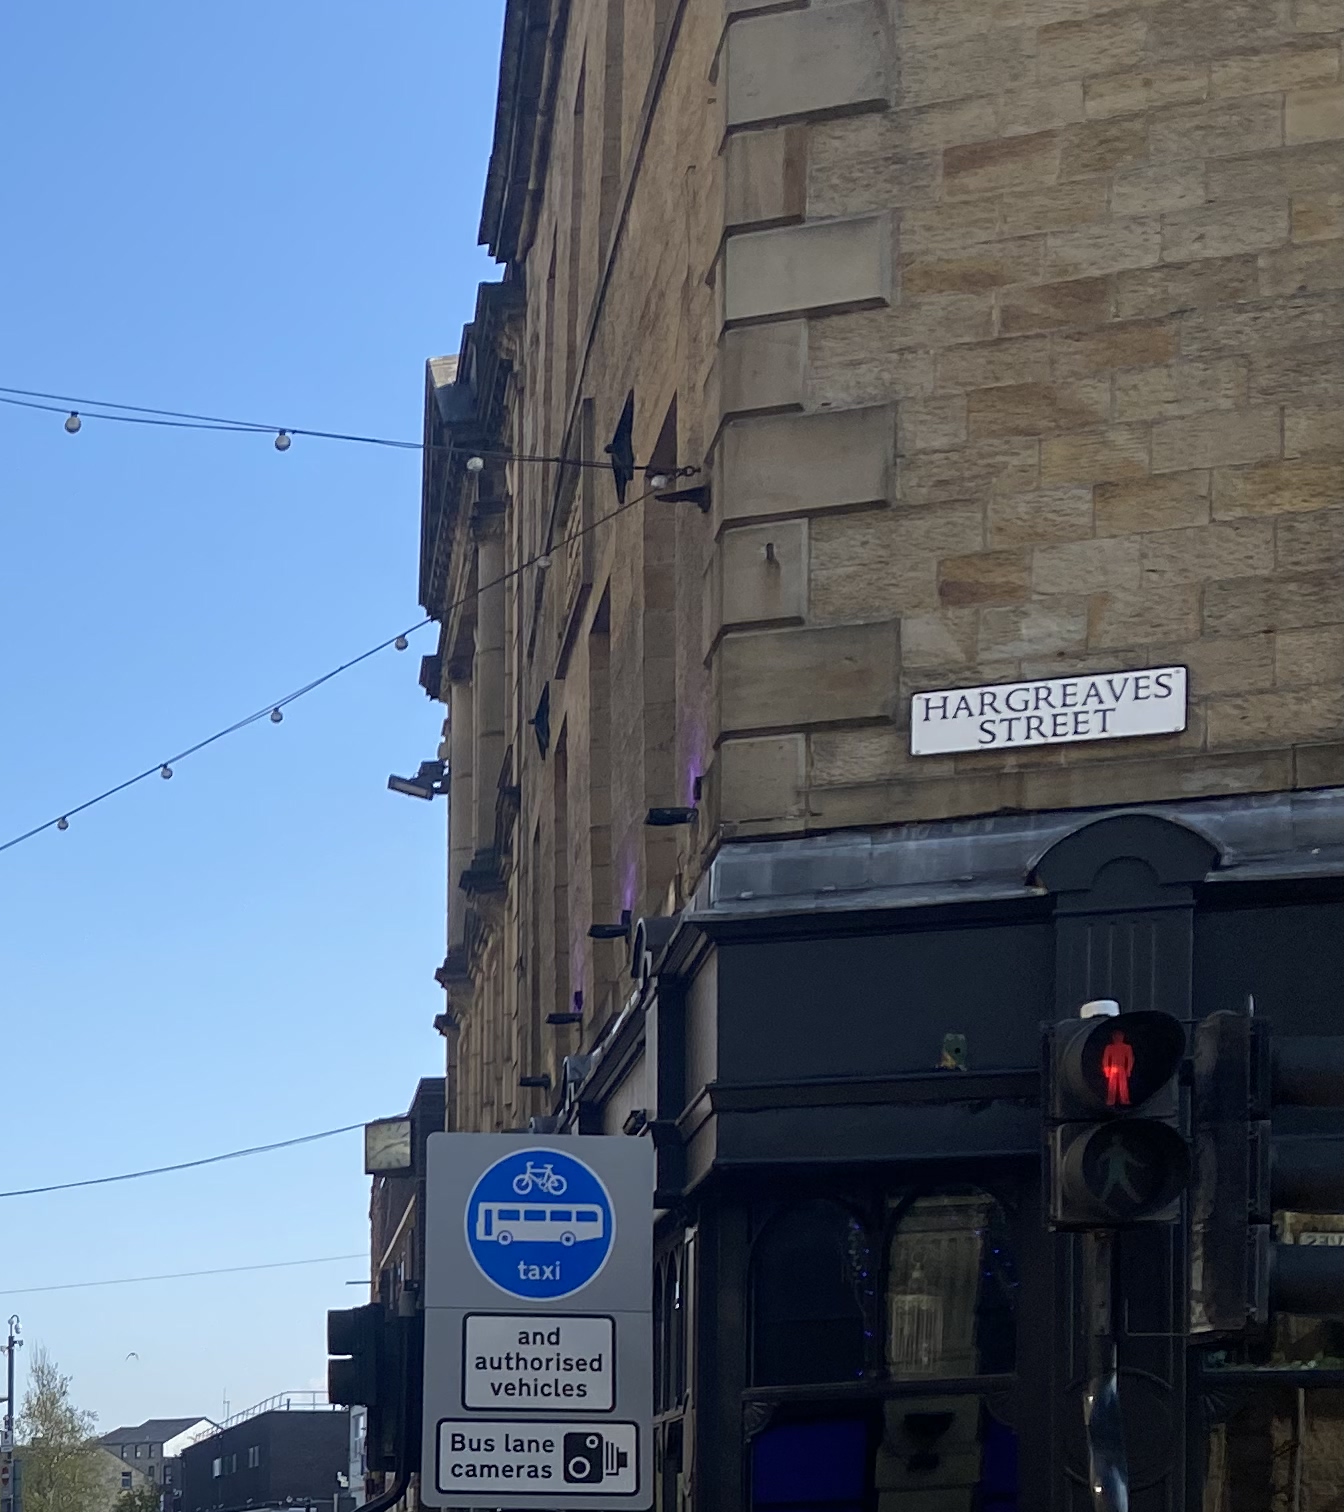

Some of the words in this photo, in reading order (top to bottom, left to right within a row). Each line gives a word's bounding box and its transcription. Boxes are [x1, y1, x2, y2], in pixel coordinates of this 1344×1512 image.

[922, 671, 1175, 723] HARGREAVES
[977, 706, 1117, 745] STREET
[517, 1260, 561, 1281] taxi
[517, 1327, 561, 1346] and
[474, 1353, 603, 1372] authorised
[490, 1378, 587, 1398] vehicles
[450, 1433, 495, 1453] Bus
[504, 1433, 555, 1454] lane
[450, 1461, 553, 1479] cameras
